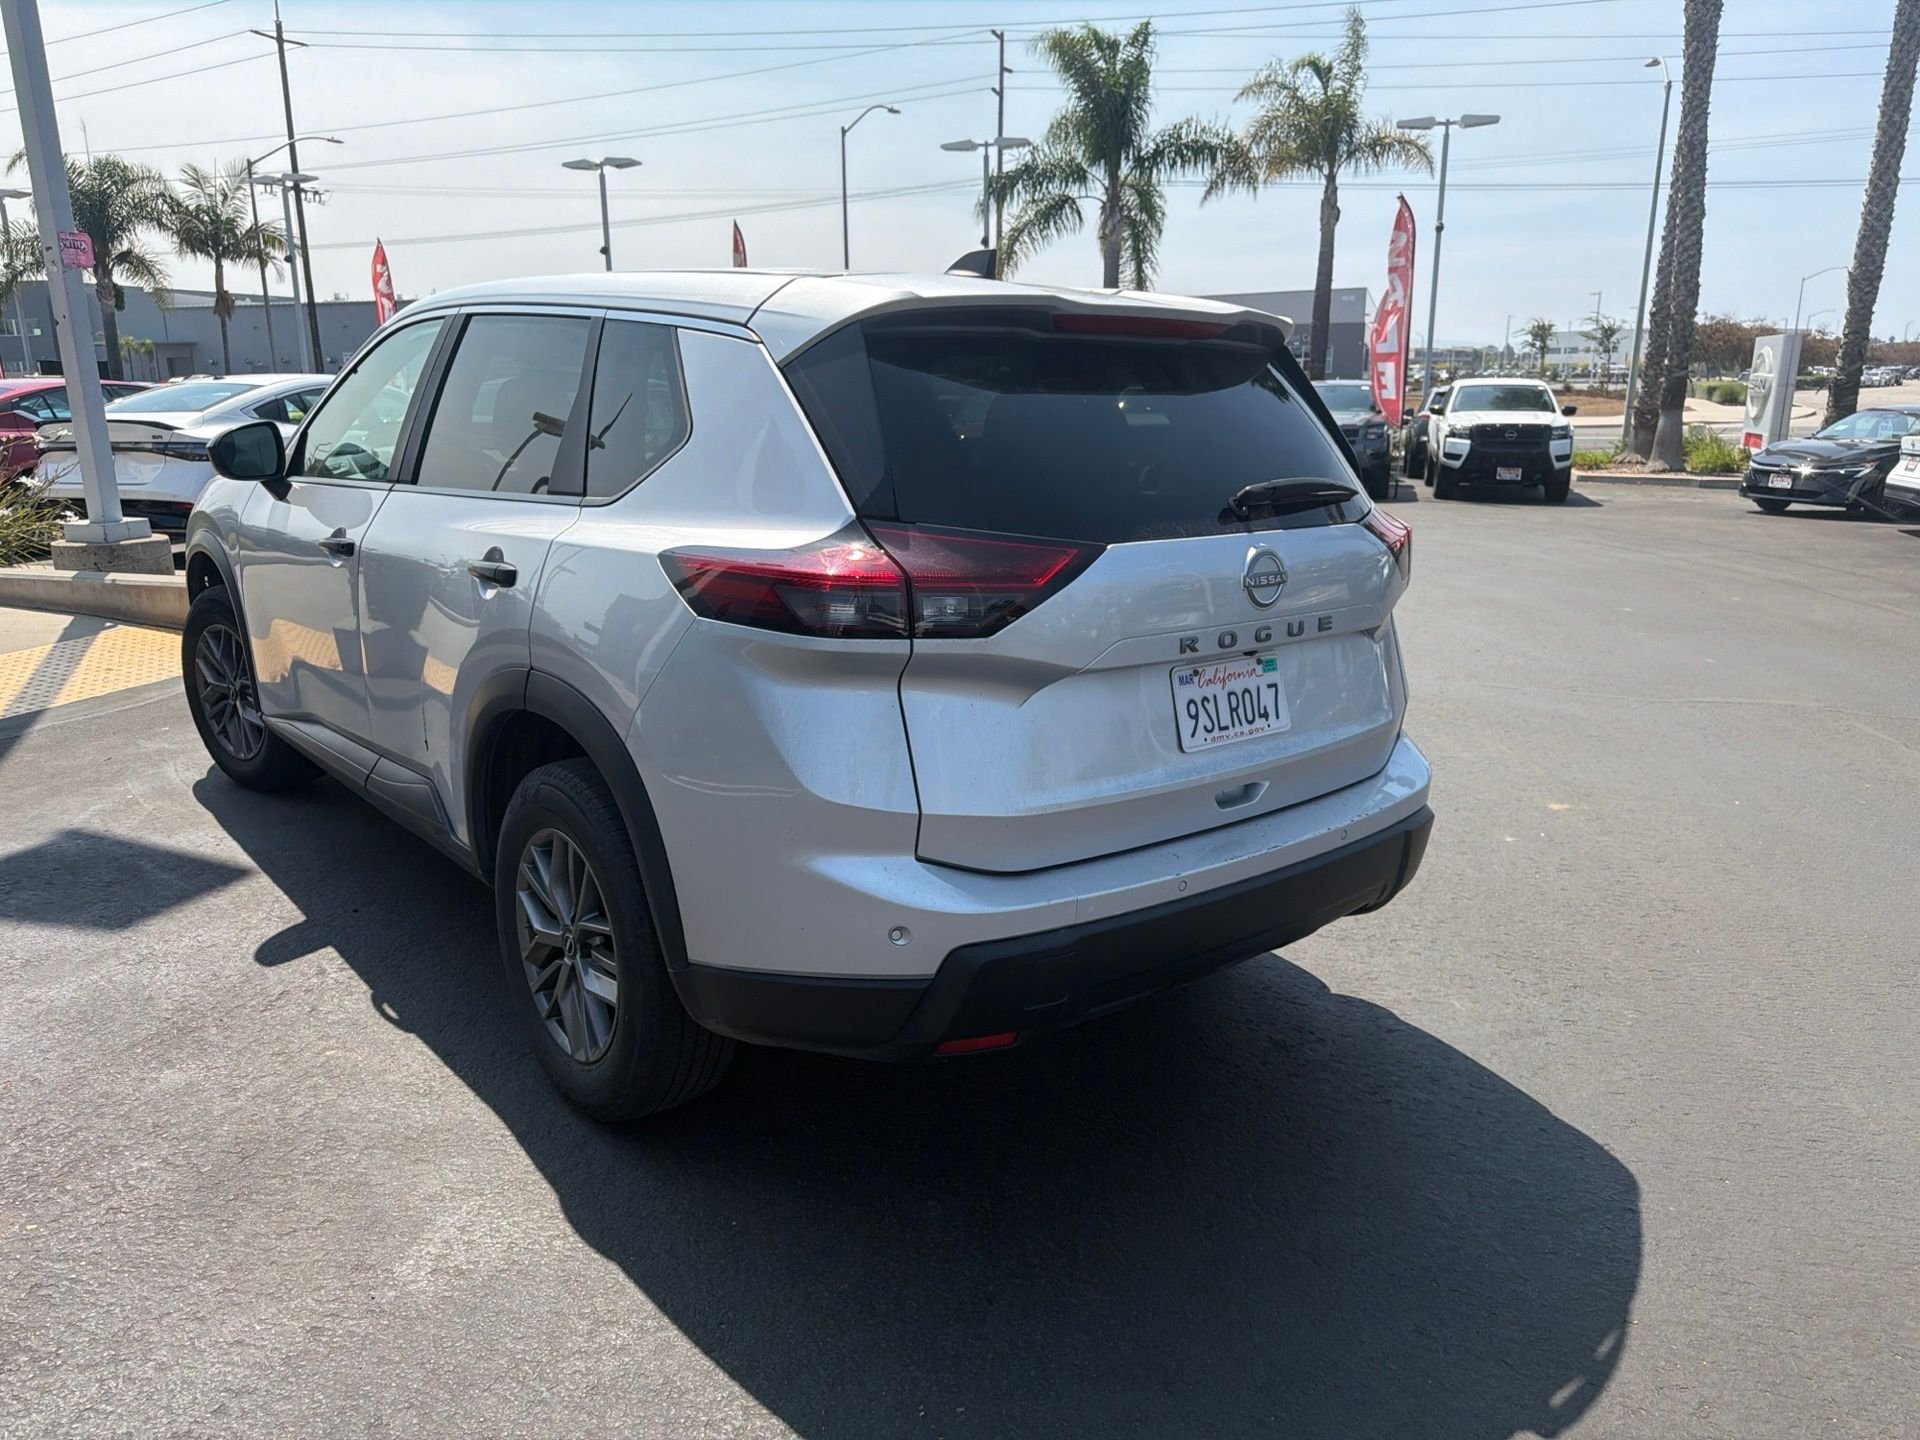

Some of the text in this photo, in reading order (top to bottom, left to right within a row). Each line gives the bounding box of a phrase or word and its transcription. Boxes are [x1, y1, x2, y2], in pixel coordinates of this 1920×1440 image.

[1246, 574, 1287, 586] NISSAN
[1179, 615, 1333, 655] ROGUE
[1178, 673, 1195, 687] MAR
[1197, 665, 1264, 690] California
[1186, 682, 1280, 739] 9SLR047
[1211, 726, 1265, 743] dmv.ca.gov
